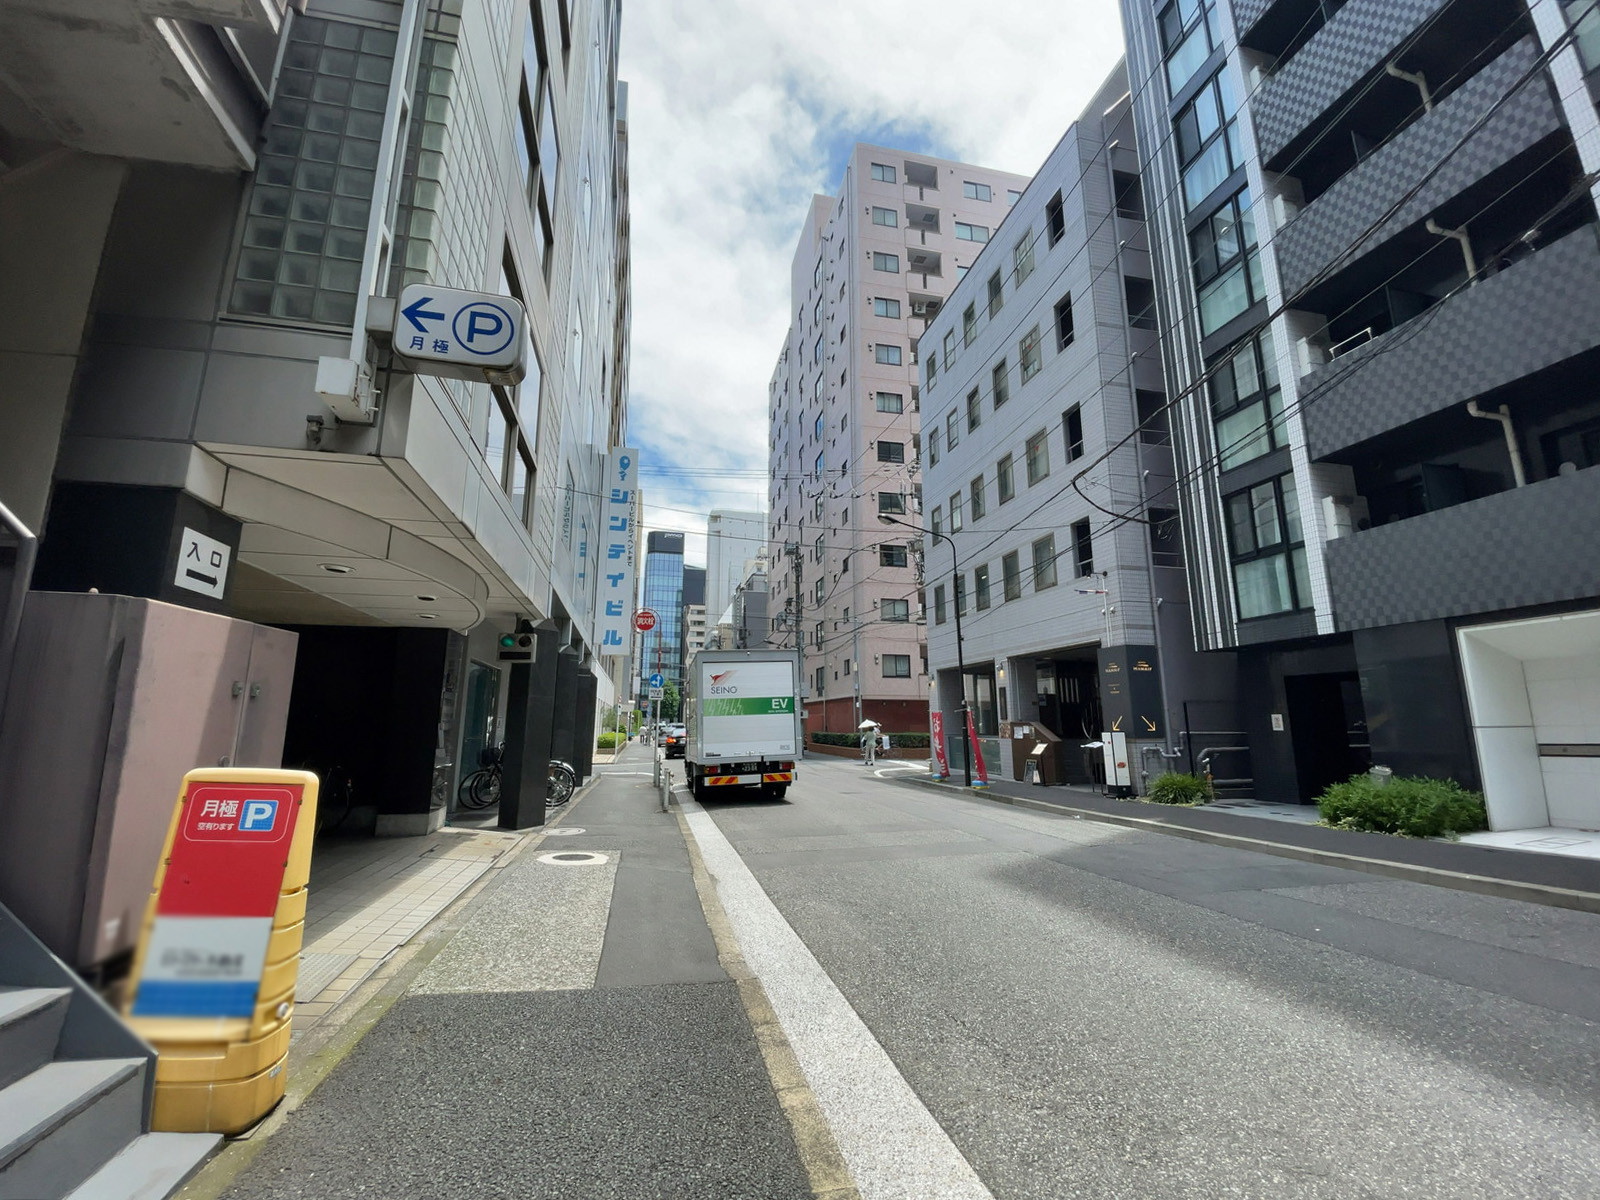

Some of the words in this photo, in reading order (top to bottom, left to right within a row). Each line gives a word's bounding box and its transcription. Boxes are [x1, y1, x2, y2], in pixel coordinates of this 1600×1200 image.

[467, 311, 503, 343] P
[409, 335, 450, 354] 月極
[187, 541, 223, 569] 入口
[603, 488, 629, 646] シンテイビル
[710, 685, 738, 695] SEINO
[771, 698, 788, 709] EV
[200, 800, 240, 818] 月極
[245, 803, 273, 829] P
[197, 822, 235, 831] 空有ります
